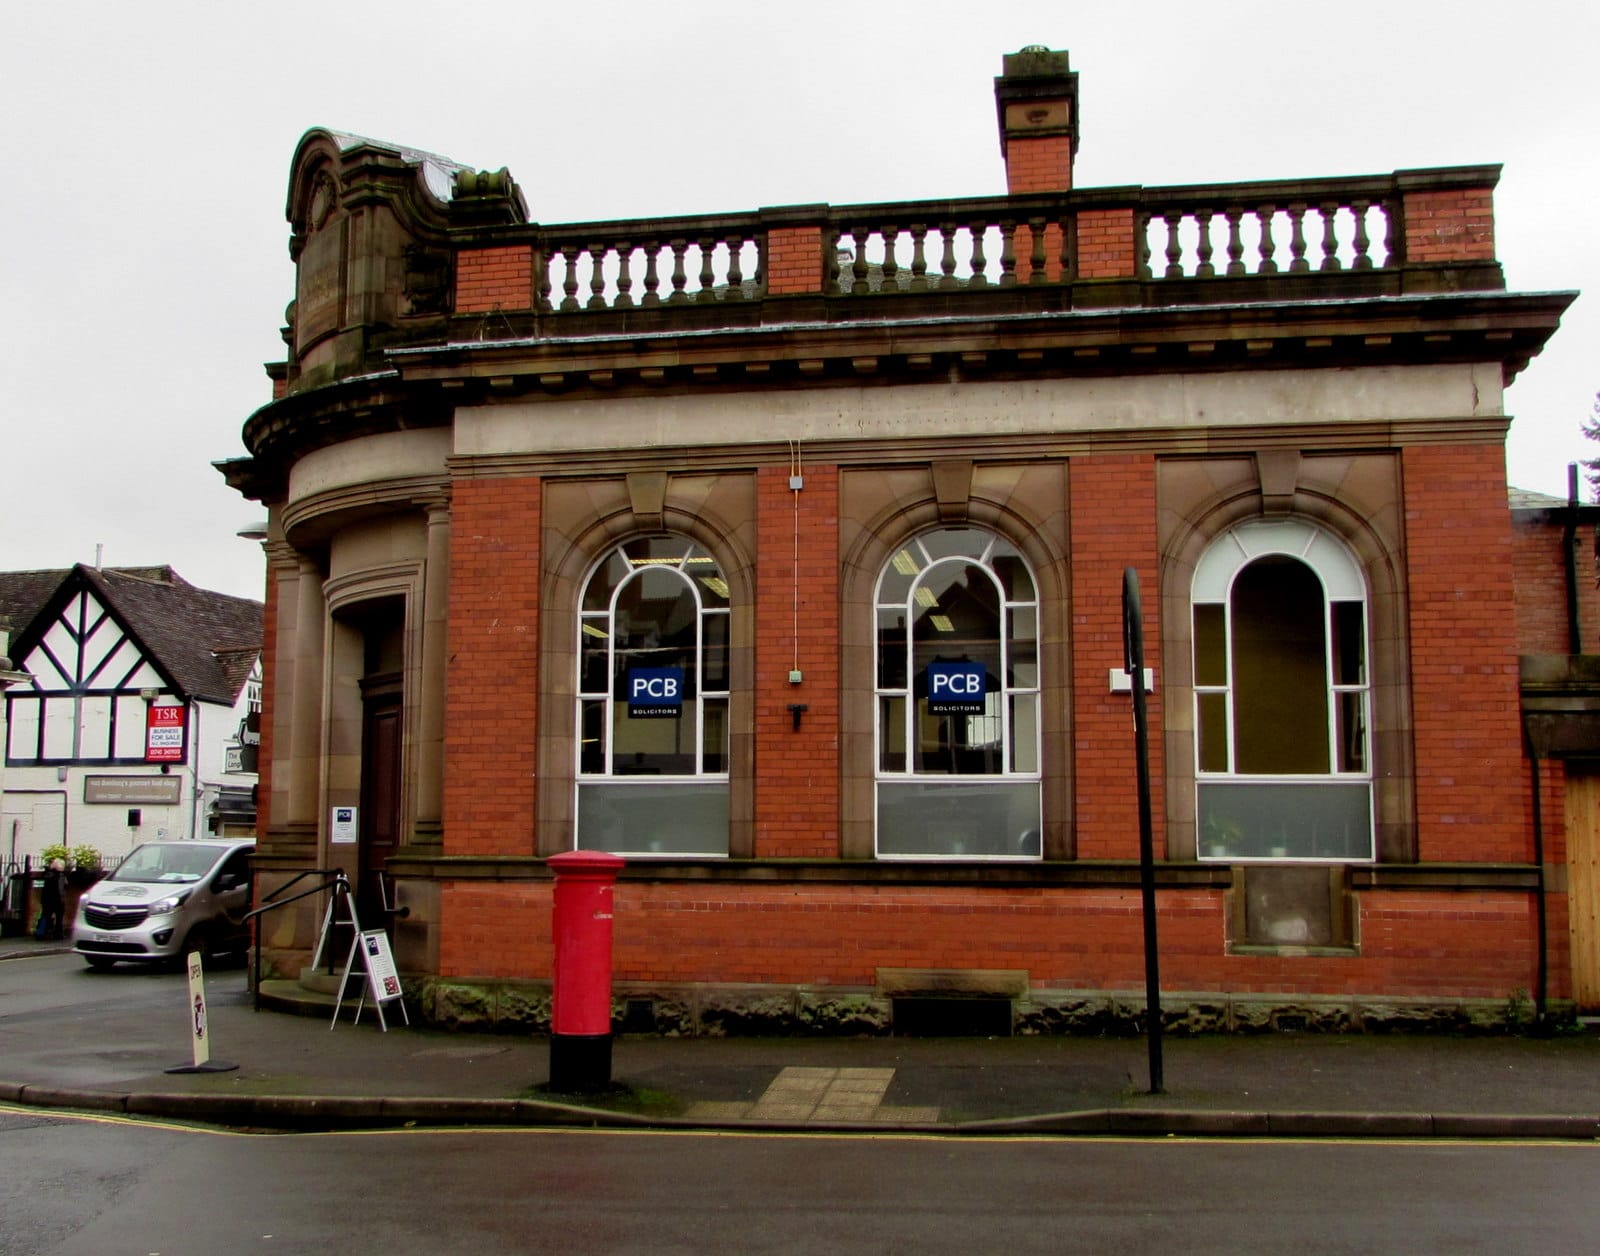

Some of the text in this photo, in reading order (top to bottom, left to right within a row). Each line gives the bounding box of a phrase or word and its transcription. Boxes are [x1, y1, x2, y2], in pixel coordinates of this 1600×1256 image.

[633, 678, 677, 698] PCB
[933, 673, 980, 694] PCB
[155, 708, 179, 720] TSR
